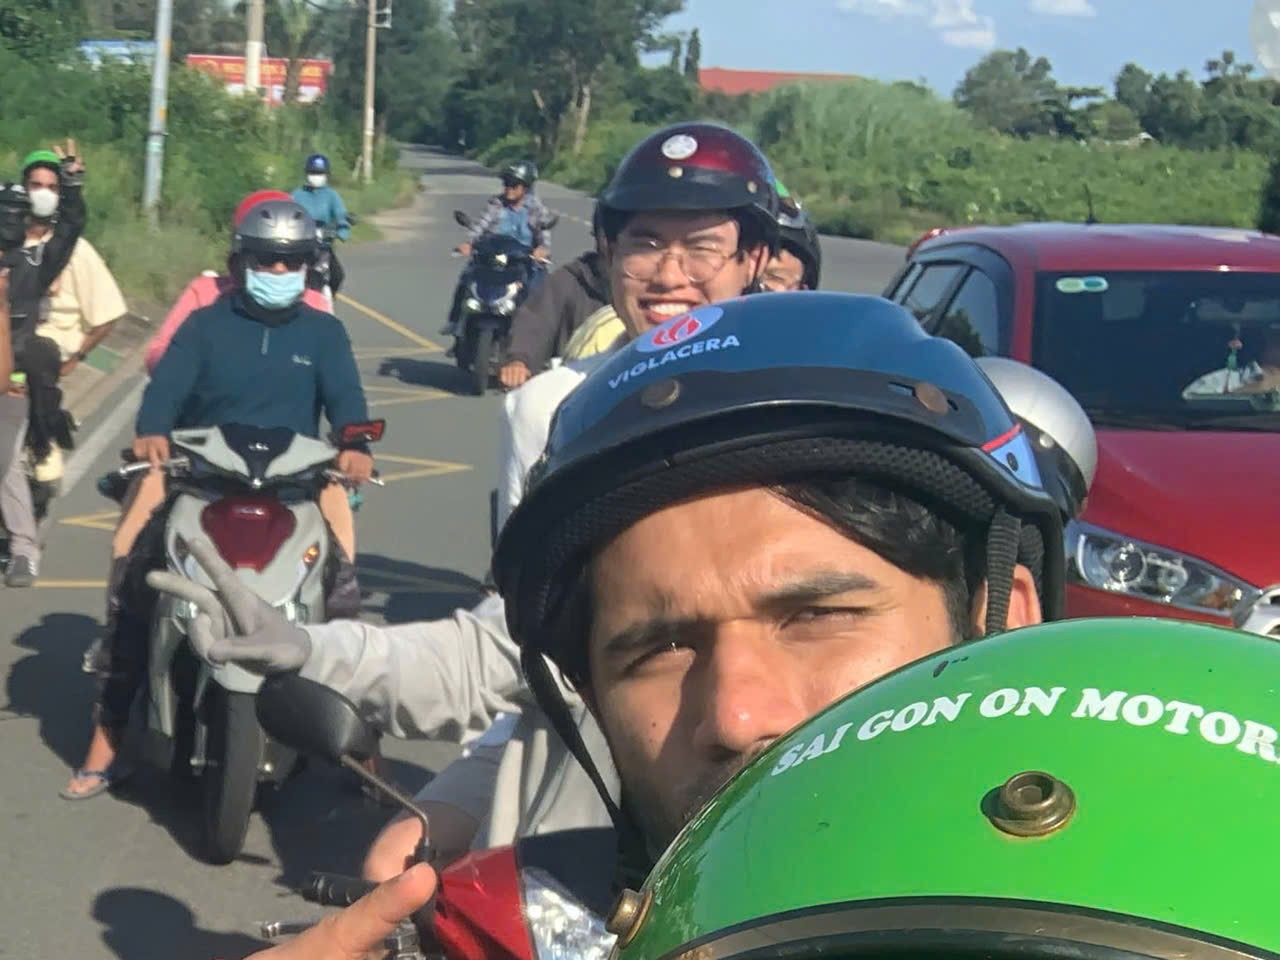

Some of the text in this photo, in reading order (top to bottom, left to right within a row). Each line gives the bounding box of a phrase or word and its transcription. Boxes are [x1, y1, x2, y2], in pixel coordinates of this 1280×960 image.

[771, 687, 1280, 776] SAI GON ON MOTOR
